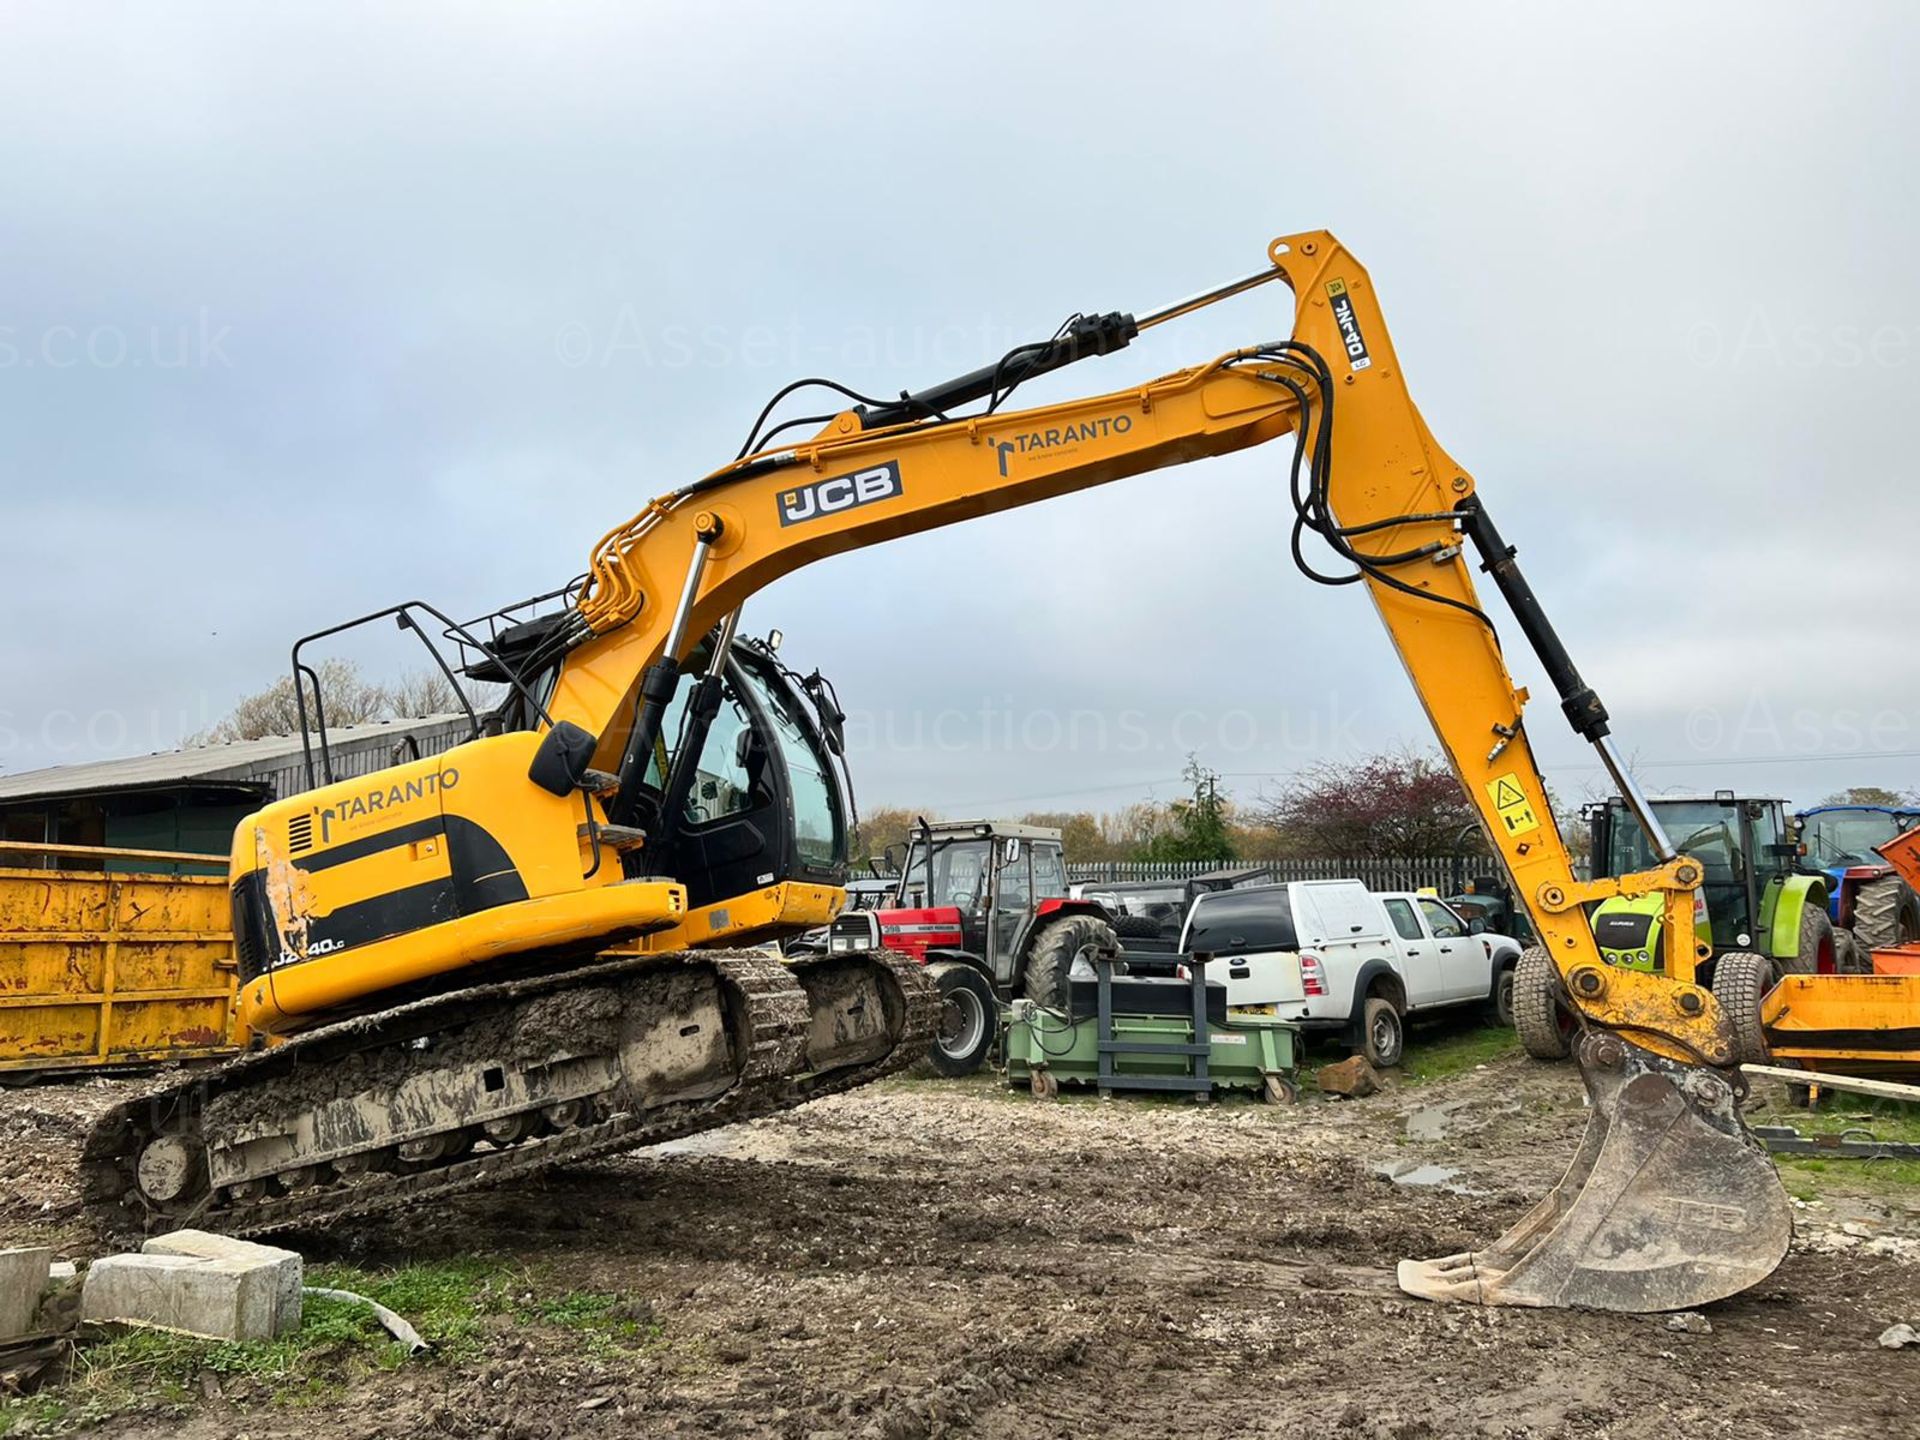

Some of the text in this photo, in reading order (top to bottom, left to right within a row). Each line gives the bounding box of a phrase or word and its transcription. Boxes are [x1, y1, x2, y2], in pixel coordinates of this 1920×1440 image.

[1015, 414, 1132, 453] TARANTO
[786, 467, 894, 521] JCB
[336, 767, 460, 821] TARANTO
